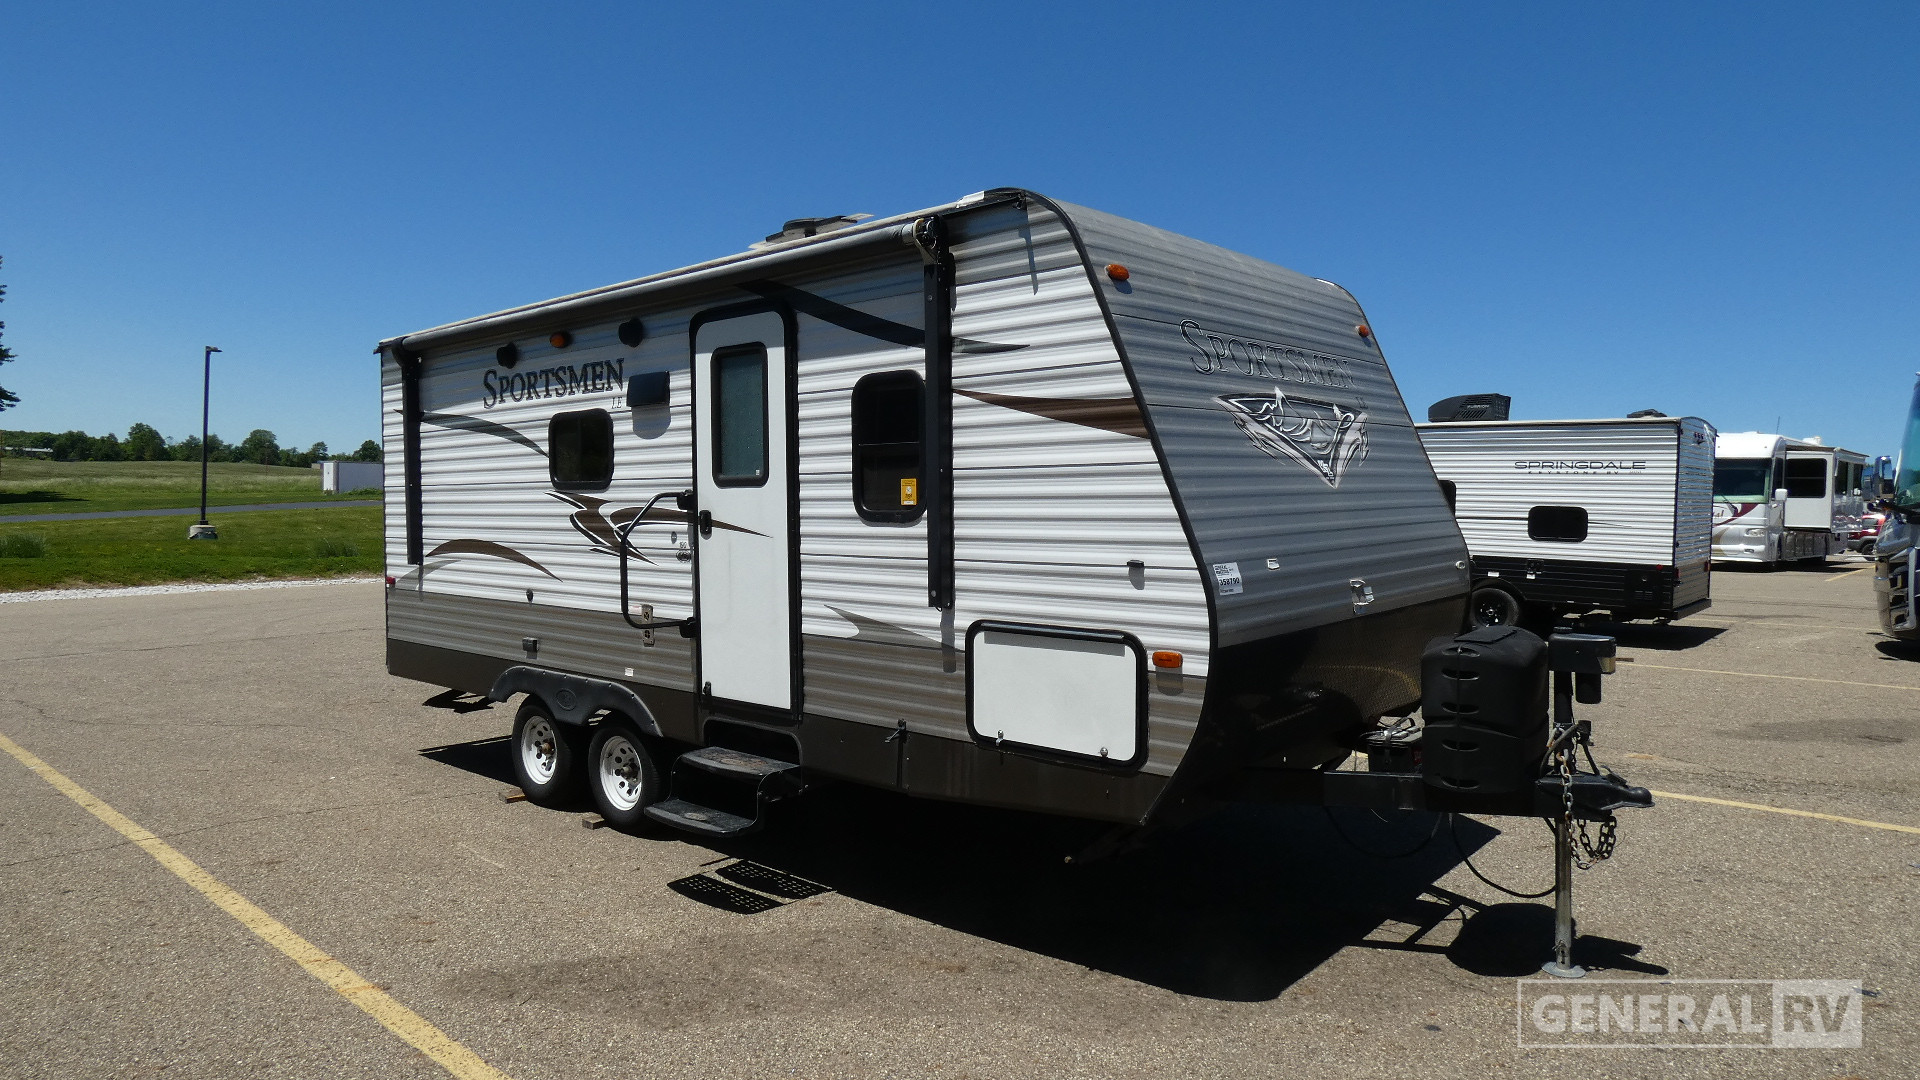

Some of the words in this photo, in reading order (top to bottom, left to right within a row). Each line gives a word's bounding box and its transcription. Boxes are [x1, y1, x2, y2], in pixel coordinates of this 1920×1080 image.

[1180, 319, 1357, 389] SPORTSMEN
[483, 358, 625, 409] SPORTSMEN
[611, 396, 622, 409] LE
[1514, 461, 1647, 470] SPRINGDALE
